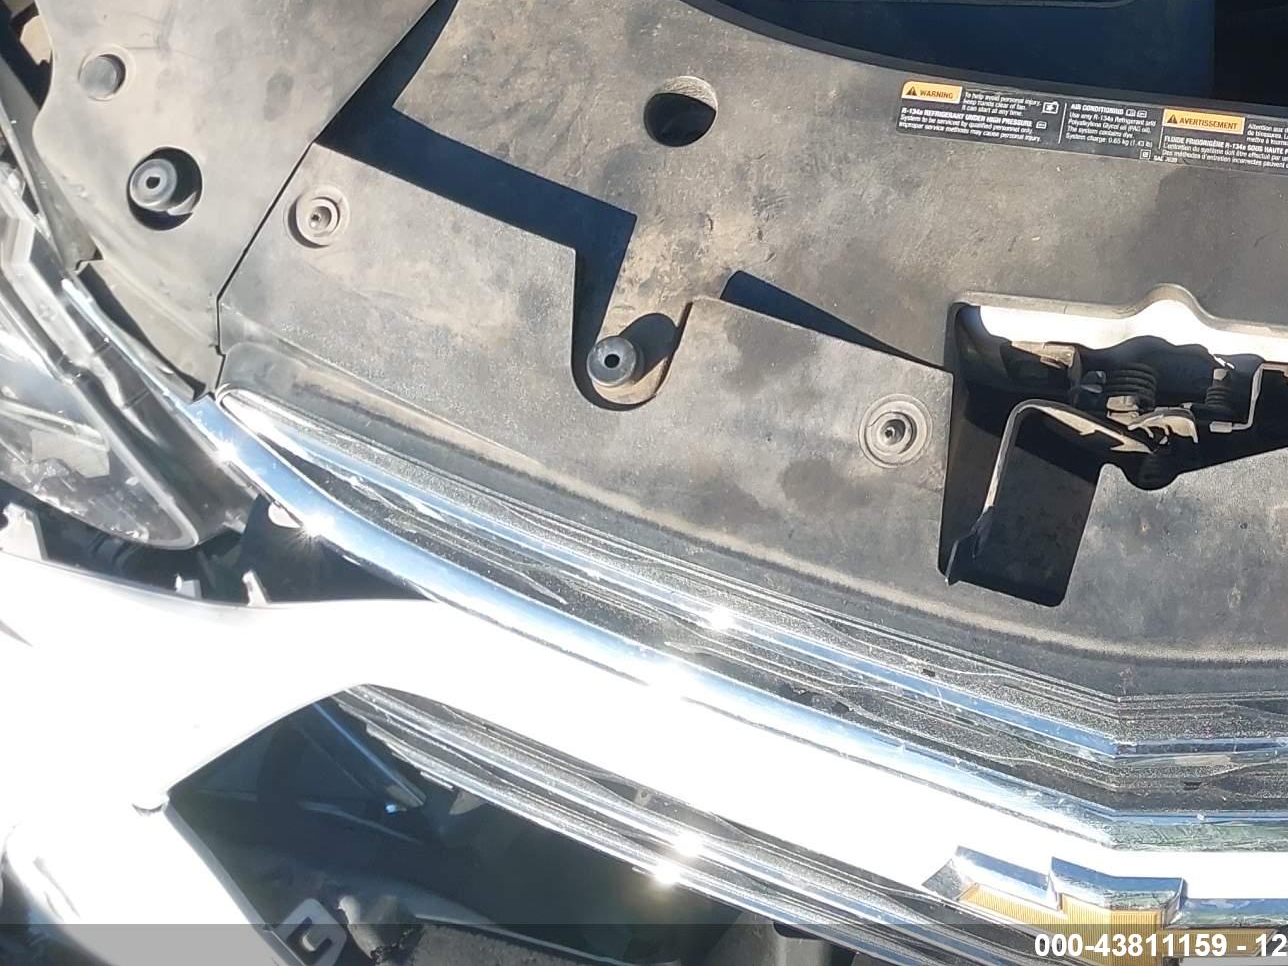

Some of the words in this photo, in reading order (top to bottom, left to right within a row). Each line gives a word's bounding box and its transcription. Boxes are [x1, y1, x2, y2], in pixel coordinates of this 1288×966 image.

[919, 88, 953, 99] WARNING
[984, 93, 999, 101] avoid
[1000, 95, 1024, 105] personal
[901, 106, 923, 115] R-134a
[923, 108, 964, 120] REFRIGERANT
[1001, 117, 1032, 127] PRESSURE
[960, 120, 968, 128] by
[1179, 116, 1237, 130] AVERTISSEMENT
[1078, 126, 1098, 135] system
